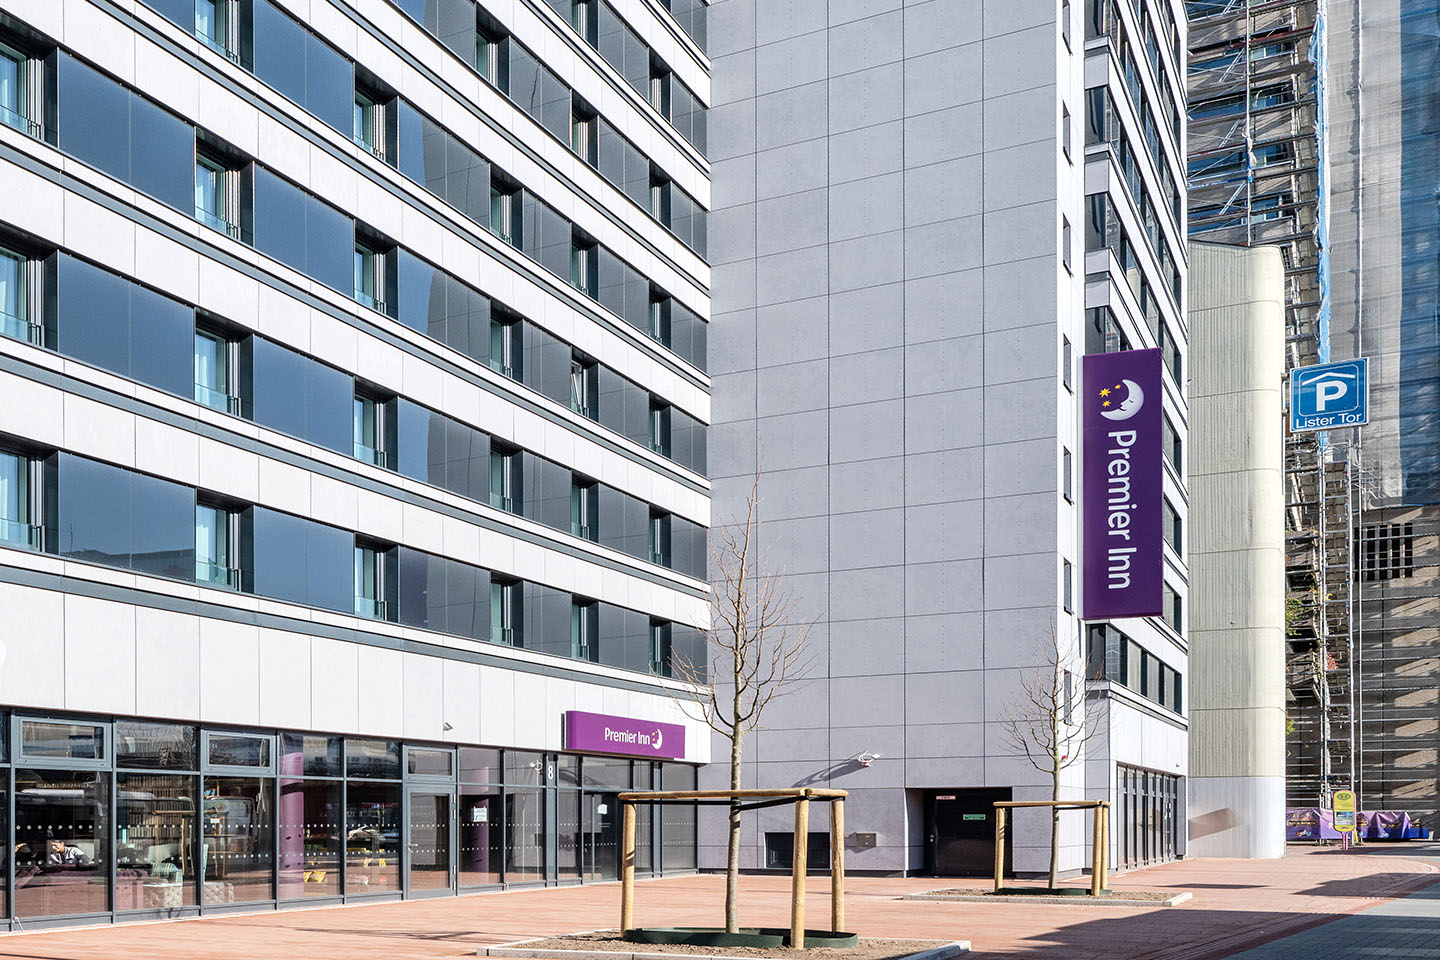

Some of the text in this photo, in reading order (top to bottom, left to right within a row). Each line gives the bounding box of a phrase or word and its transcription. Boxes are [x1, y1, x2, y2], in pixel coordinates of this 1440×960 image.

[1316, 380, 1348, 412] P
[1295, 412, 1363, 429] Lister Tor
[1107, 429, 1138, 590] Premier Inn
[604, 727, 651, 746] Premier Inn
[547, 764, 554, 780] 8
